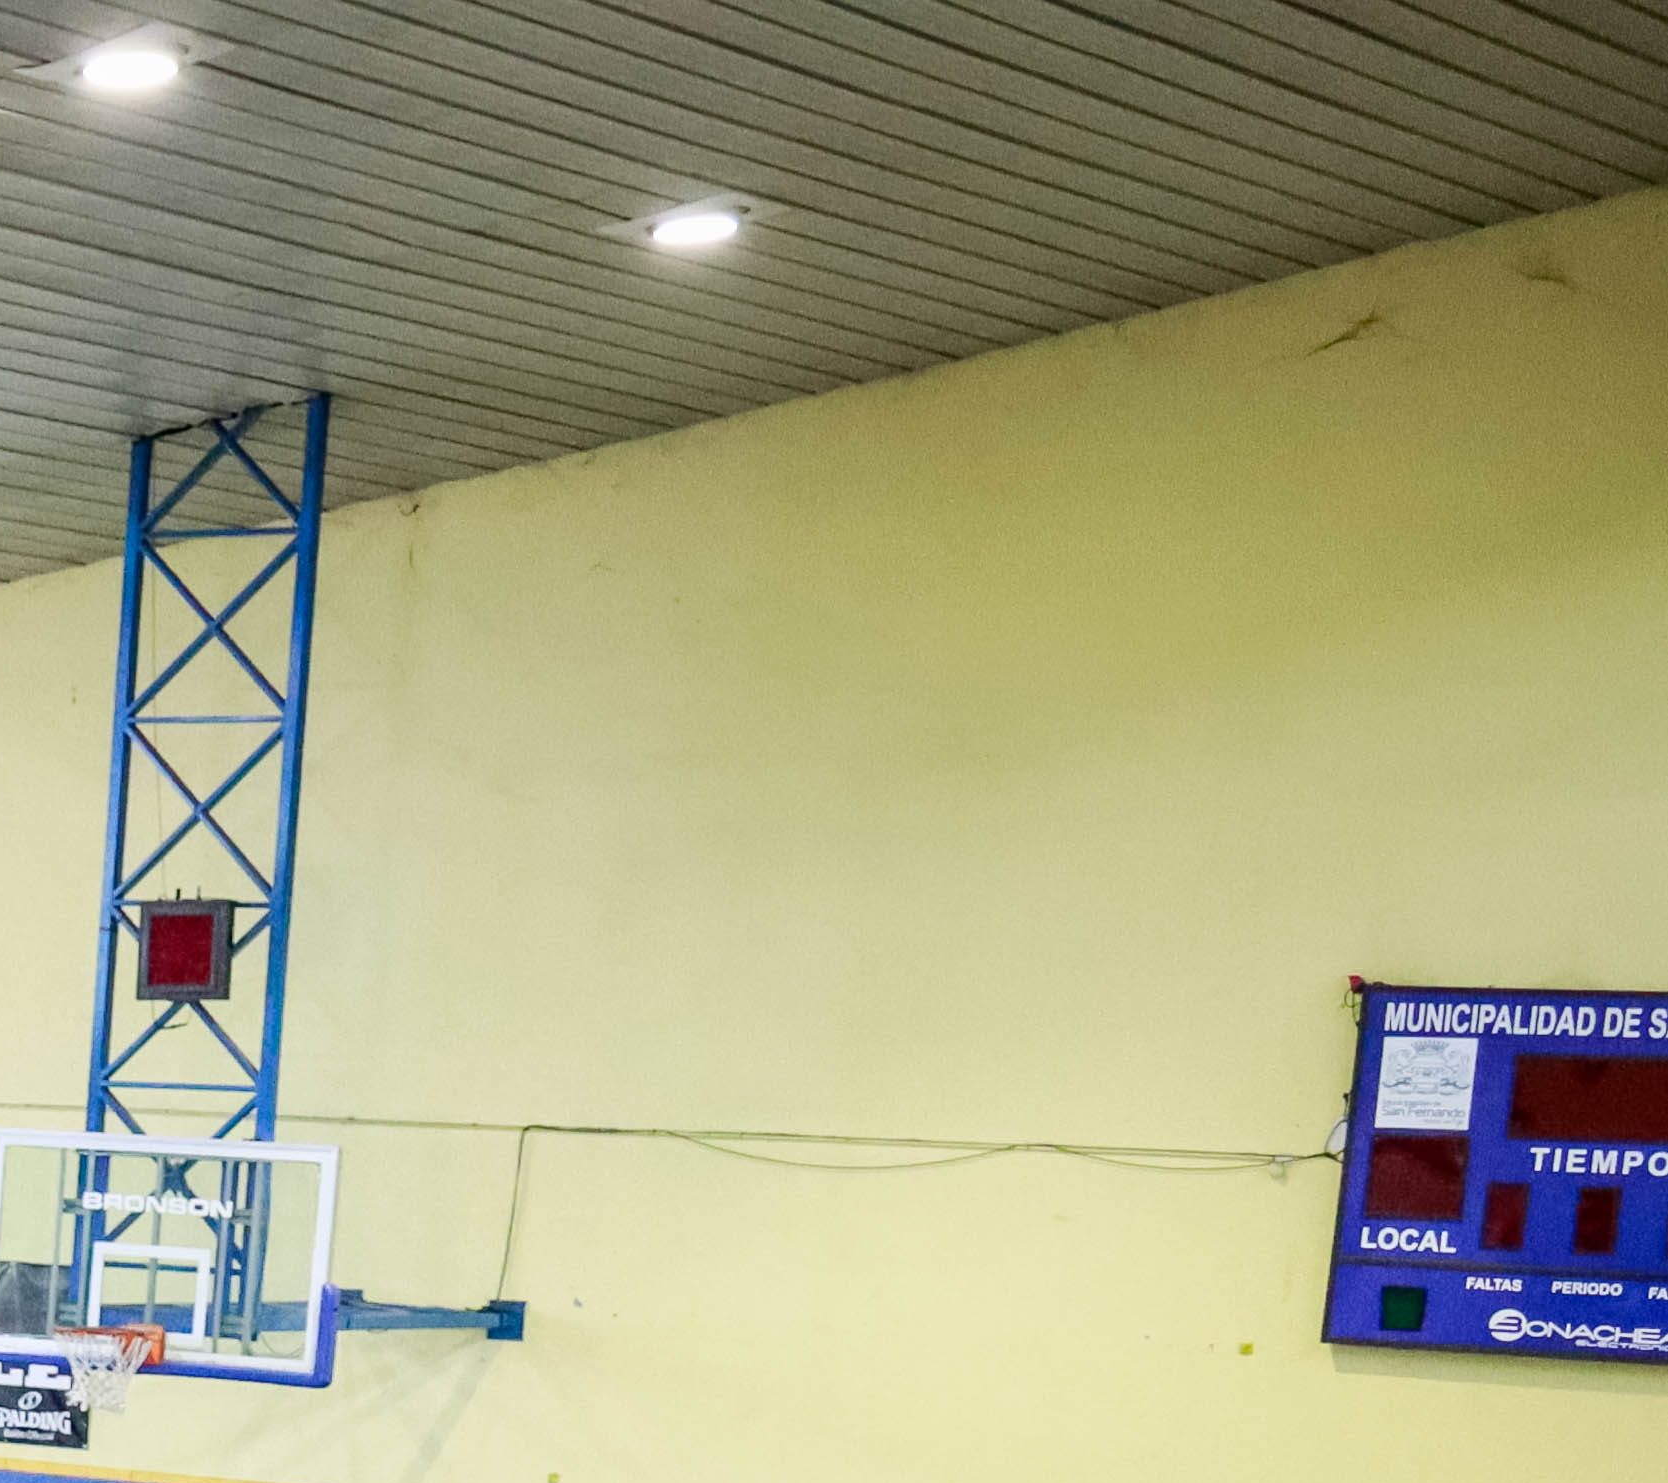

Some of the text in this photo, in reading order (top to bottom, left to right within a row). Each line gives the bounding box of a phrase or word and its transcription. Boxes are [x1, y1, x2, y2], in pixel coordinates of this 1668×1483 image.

[1384, 1002, 1668, 1040] MUNICIPALIDAD DE S
[1530, 1147, 1668, 1177] TIEMPO
[82, 1190, 234, 1219] BRONSON
[1360, 1226, 1457, 1254] LOCAL
[1465, 1276, 1523, 1293] FALTAS
[1551, 1281, 1623, 1297] PERIODO
